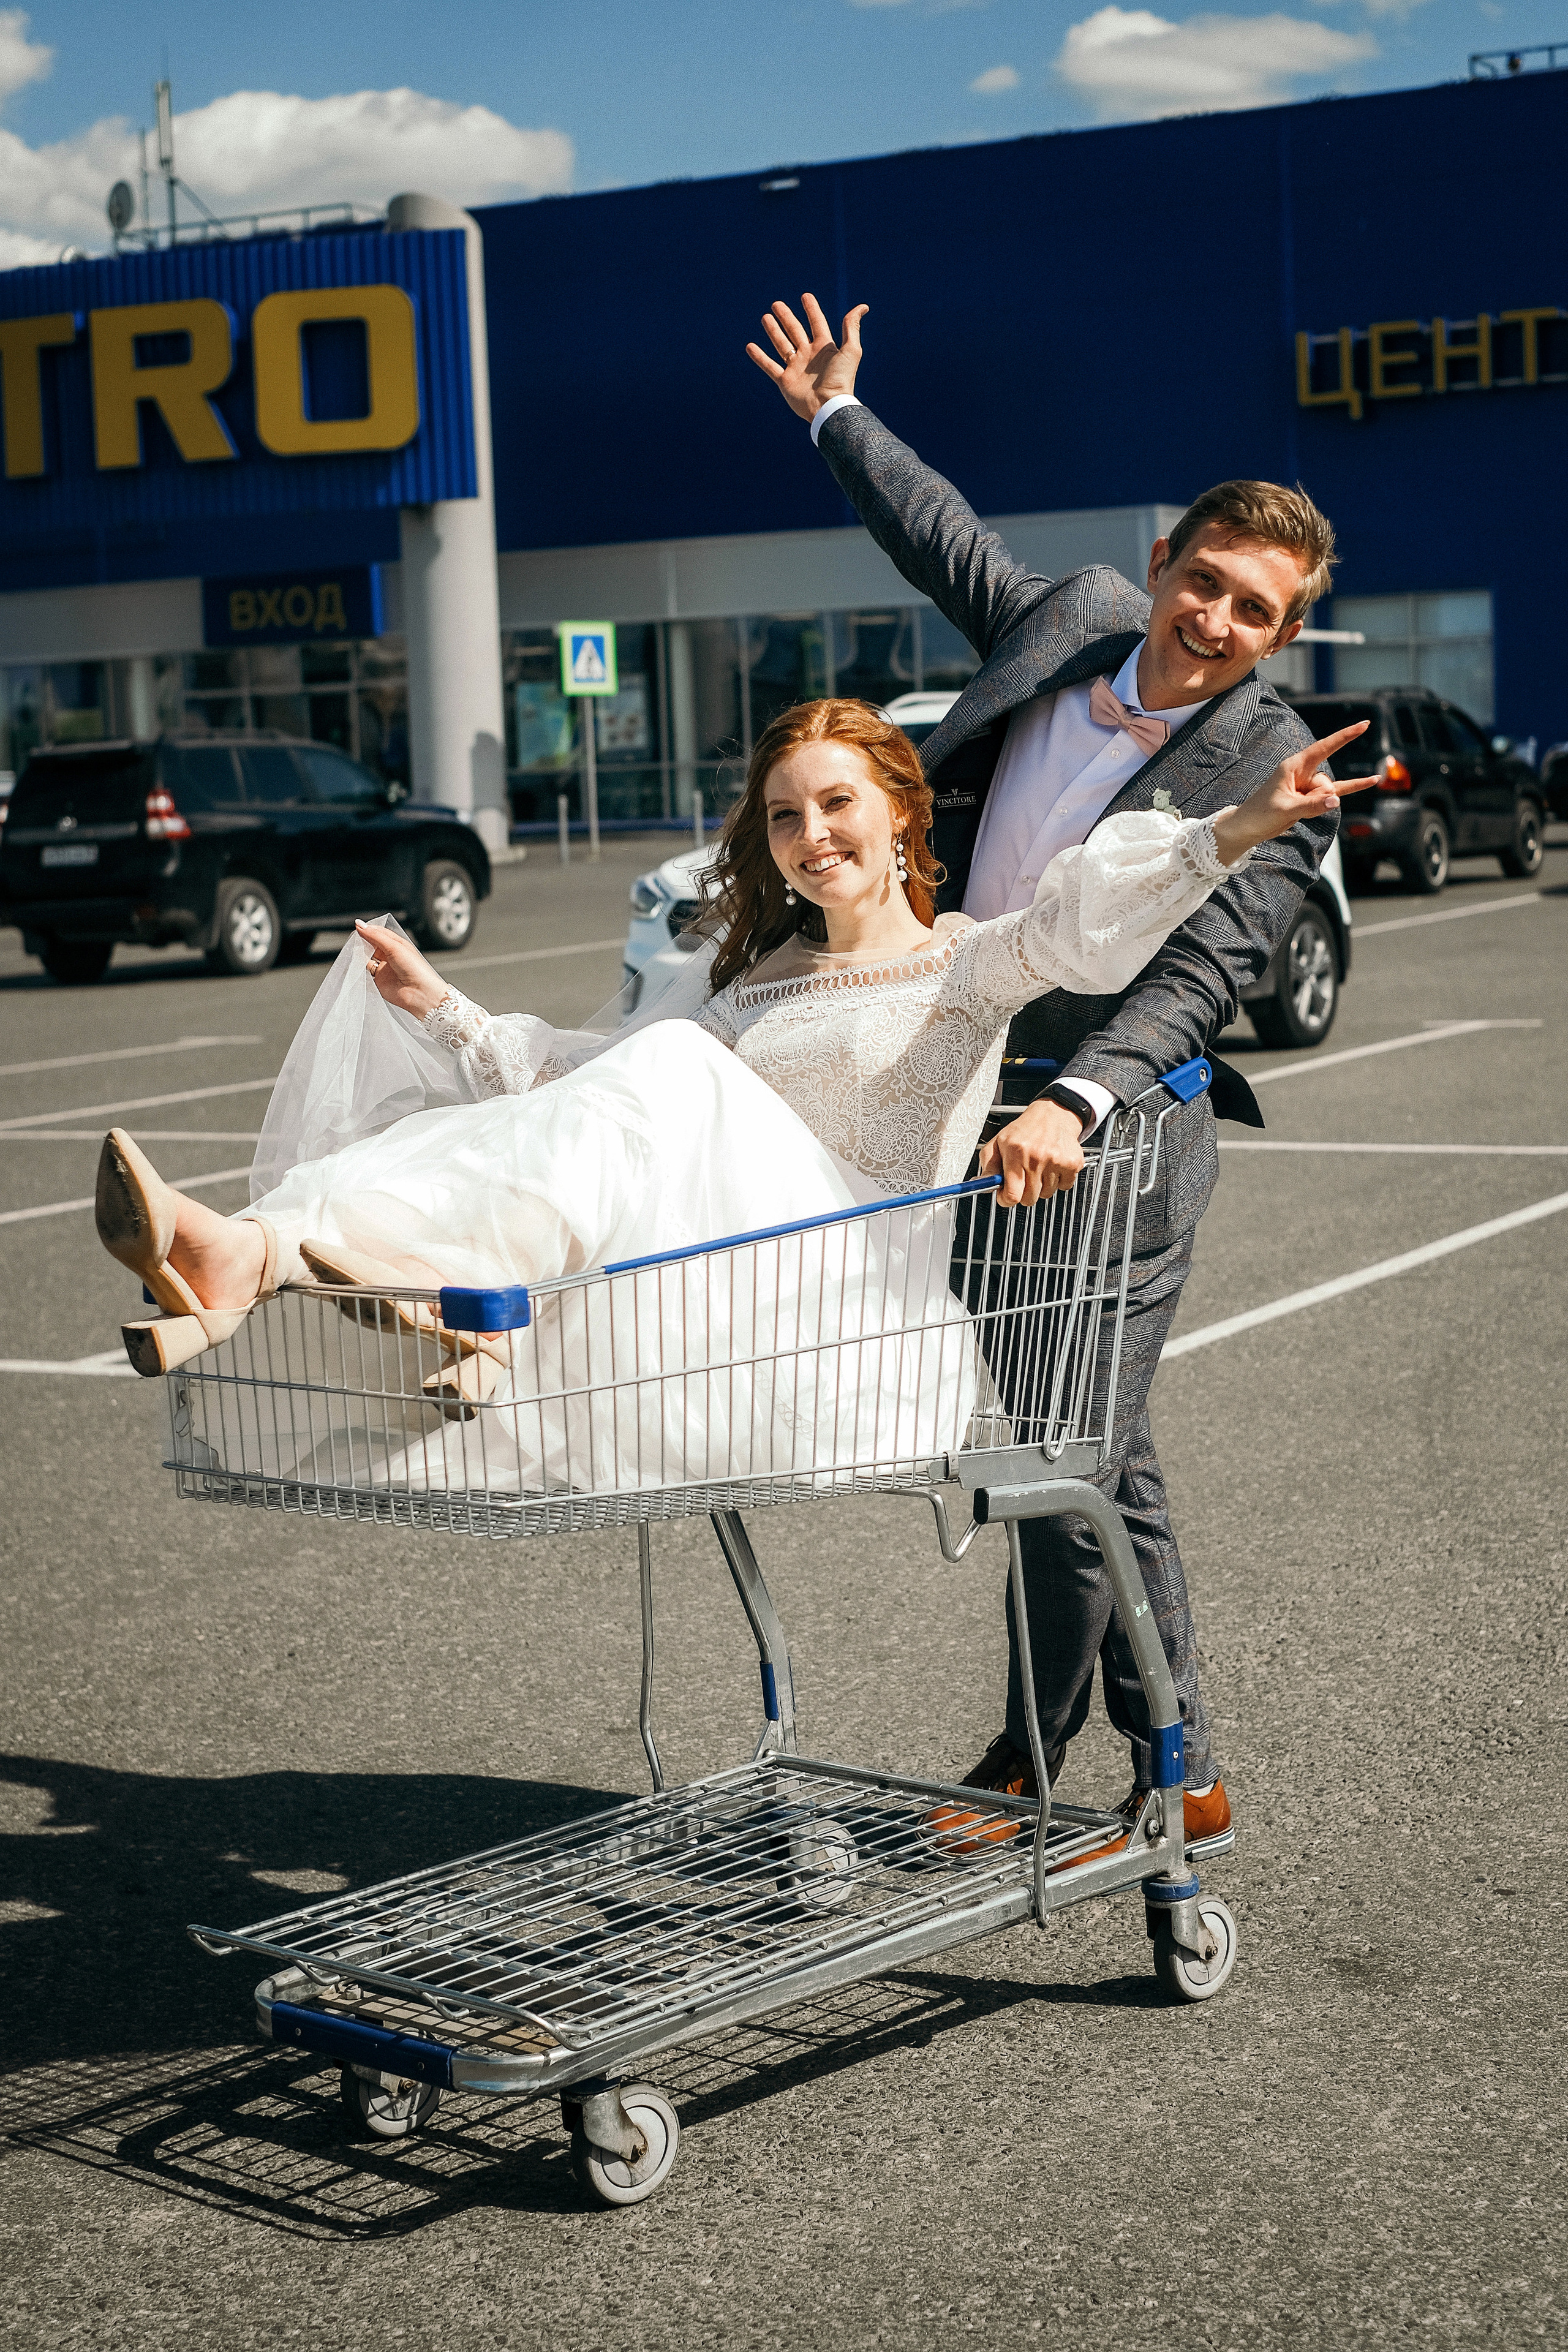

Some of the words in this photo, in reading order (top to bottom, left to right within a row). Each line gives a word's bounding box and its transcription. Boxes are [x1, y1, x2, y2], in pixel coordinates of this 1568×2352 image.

[0, 284, 420, 478] TRO
[1295, 307, 1559, 420] ЦЕНТ
[229, 583, 347, 632] ВХОД
[937, 796, 976, 805] VINCITORE
